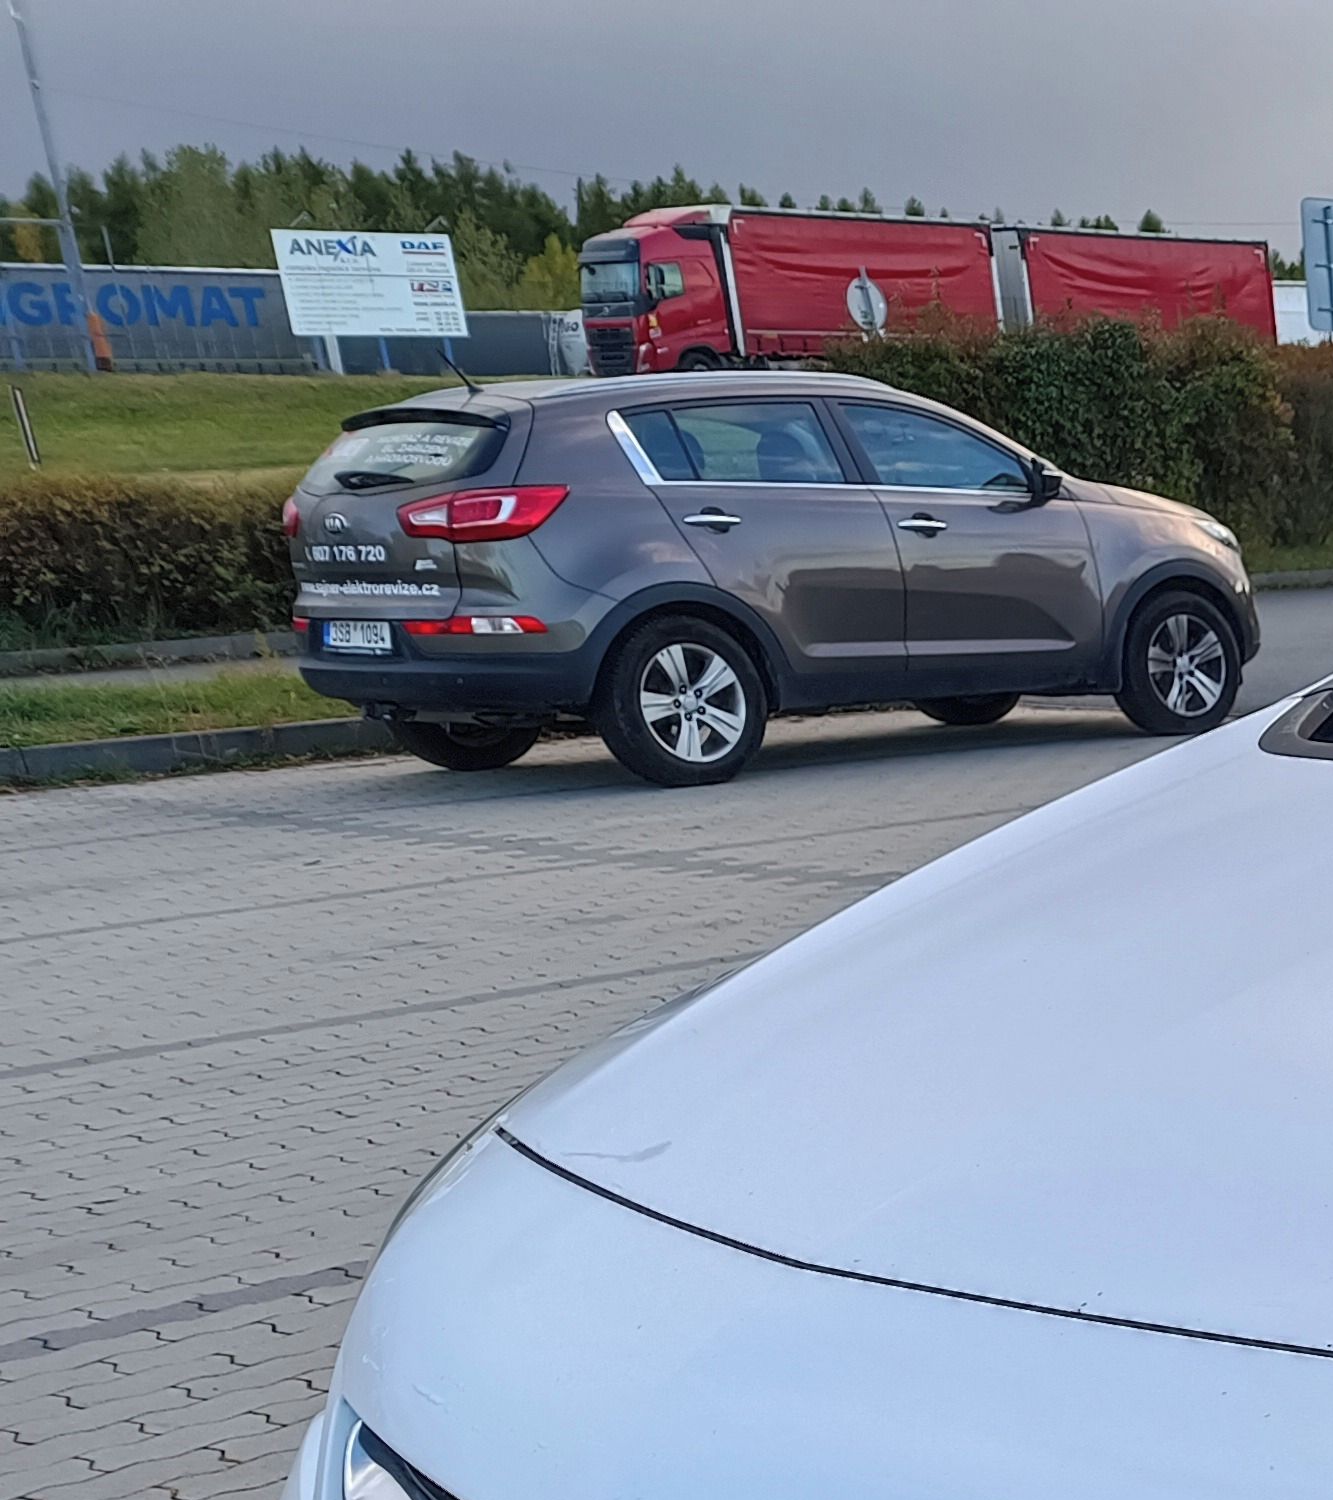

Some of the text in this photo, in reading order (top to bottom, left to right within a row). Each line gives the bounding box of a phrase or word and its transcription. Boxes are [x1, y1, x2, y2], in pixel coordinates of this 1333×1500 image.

[289, 235, 377, 262] ANEXIA
[401, 240, 446, 251] DAF
[0, 282, 265, 327] GOMAT
[333, 545, 356, 562] 176
[358, 545, 385, 562] 720
[360, 621, 386, 645] 1094
